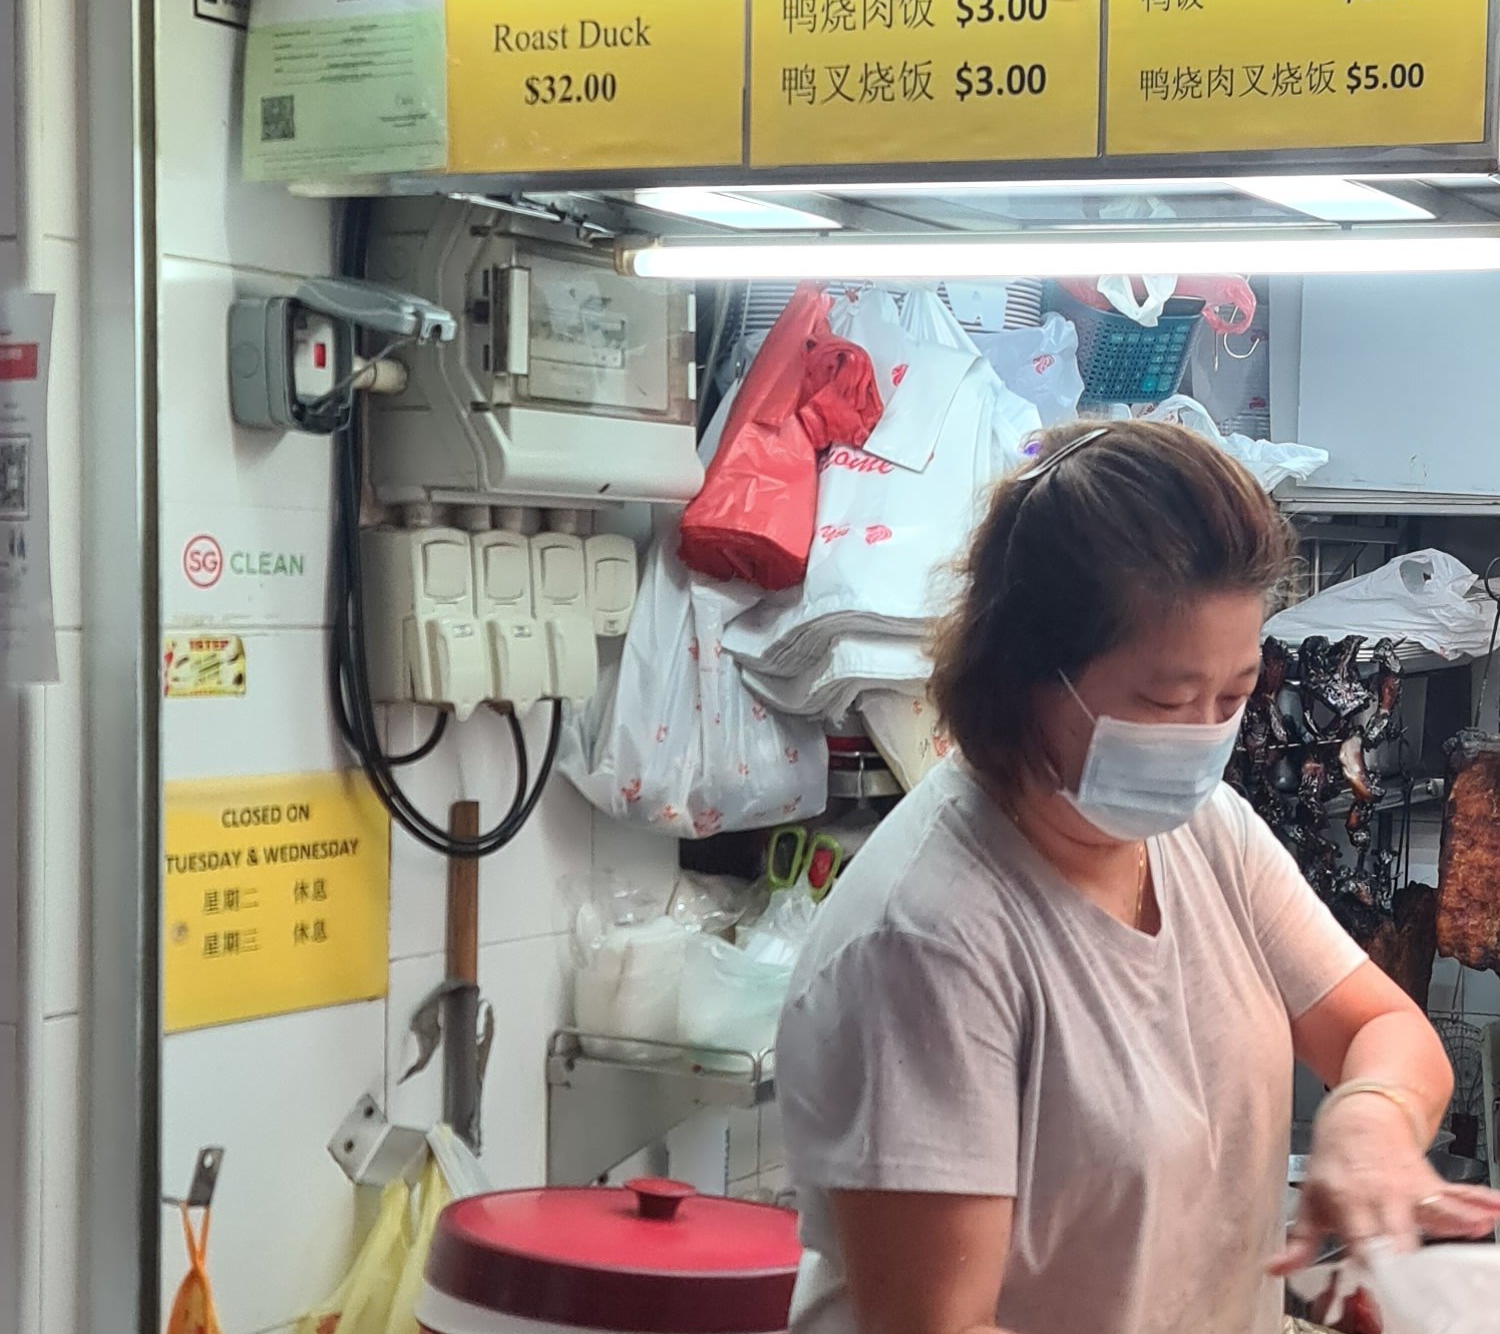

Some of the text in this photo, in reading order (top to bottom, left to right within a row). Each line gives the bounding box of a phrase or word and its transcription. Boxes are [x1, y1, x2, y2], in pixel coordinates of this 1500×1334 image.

[493, 15, 652, 53] Roast Duck
[523, 72, 617, 106] $32.00
[781, 59, 1047, 106] 鸭叉烧饭 $3.00
[1139, 60, 1425, 102] 鸭烧肉叉烧饭 $5.00
[190, 551, 305, 576] SG CLEAN
[221, 803, 311, 829] CLOSED ON
[166, 838, 360, 875] TUESDAY & WEDNESDAY
[203, 877, 329, 915] 星期二 休息
[202, 918, 329, 959] 星期三 休息
